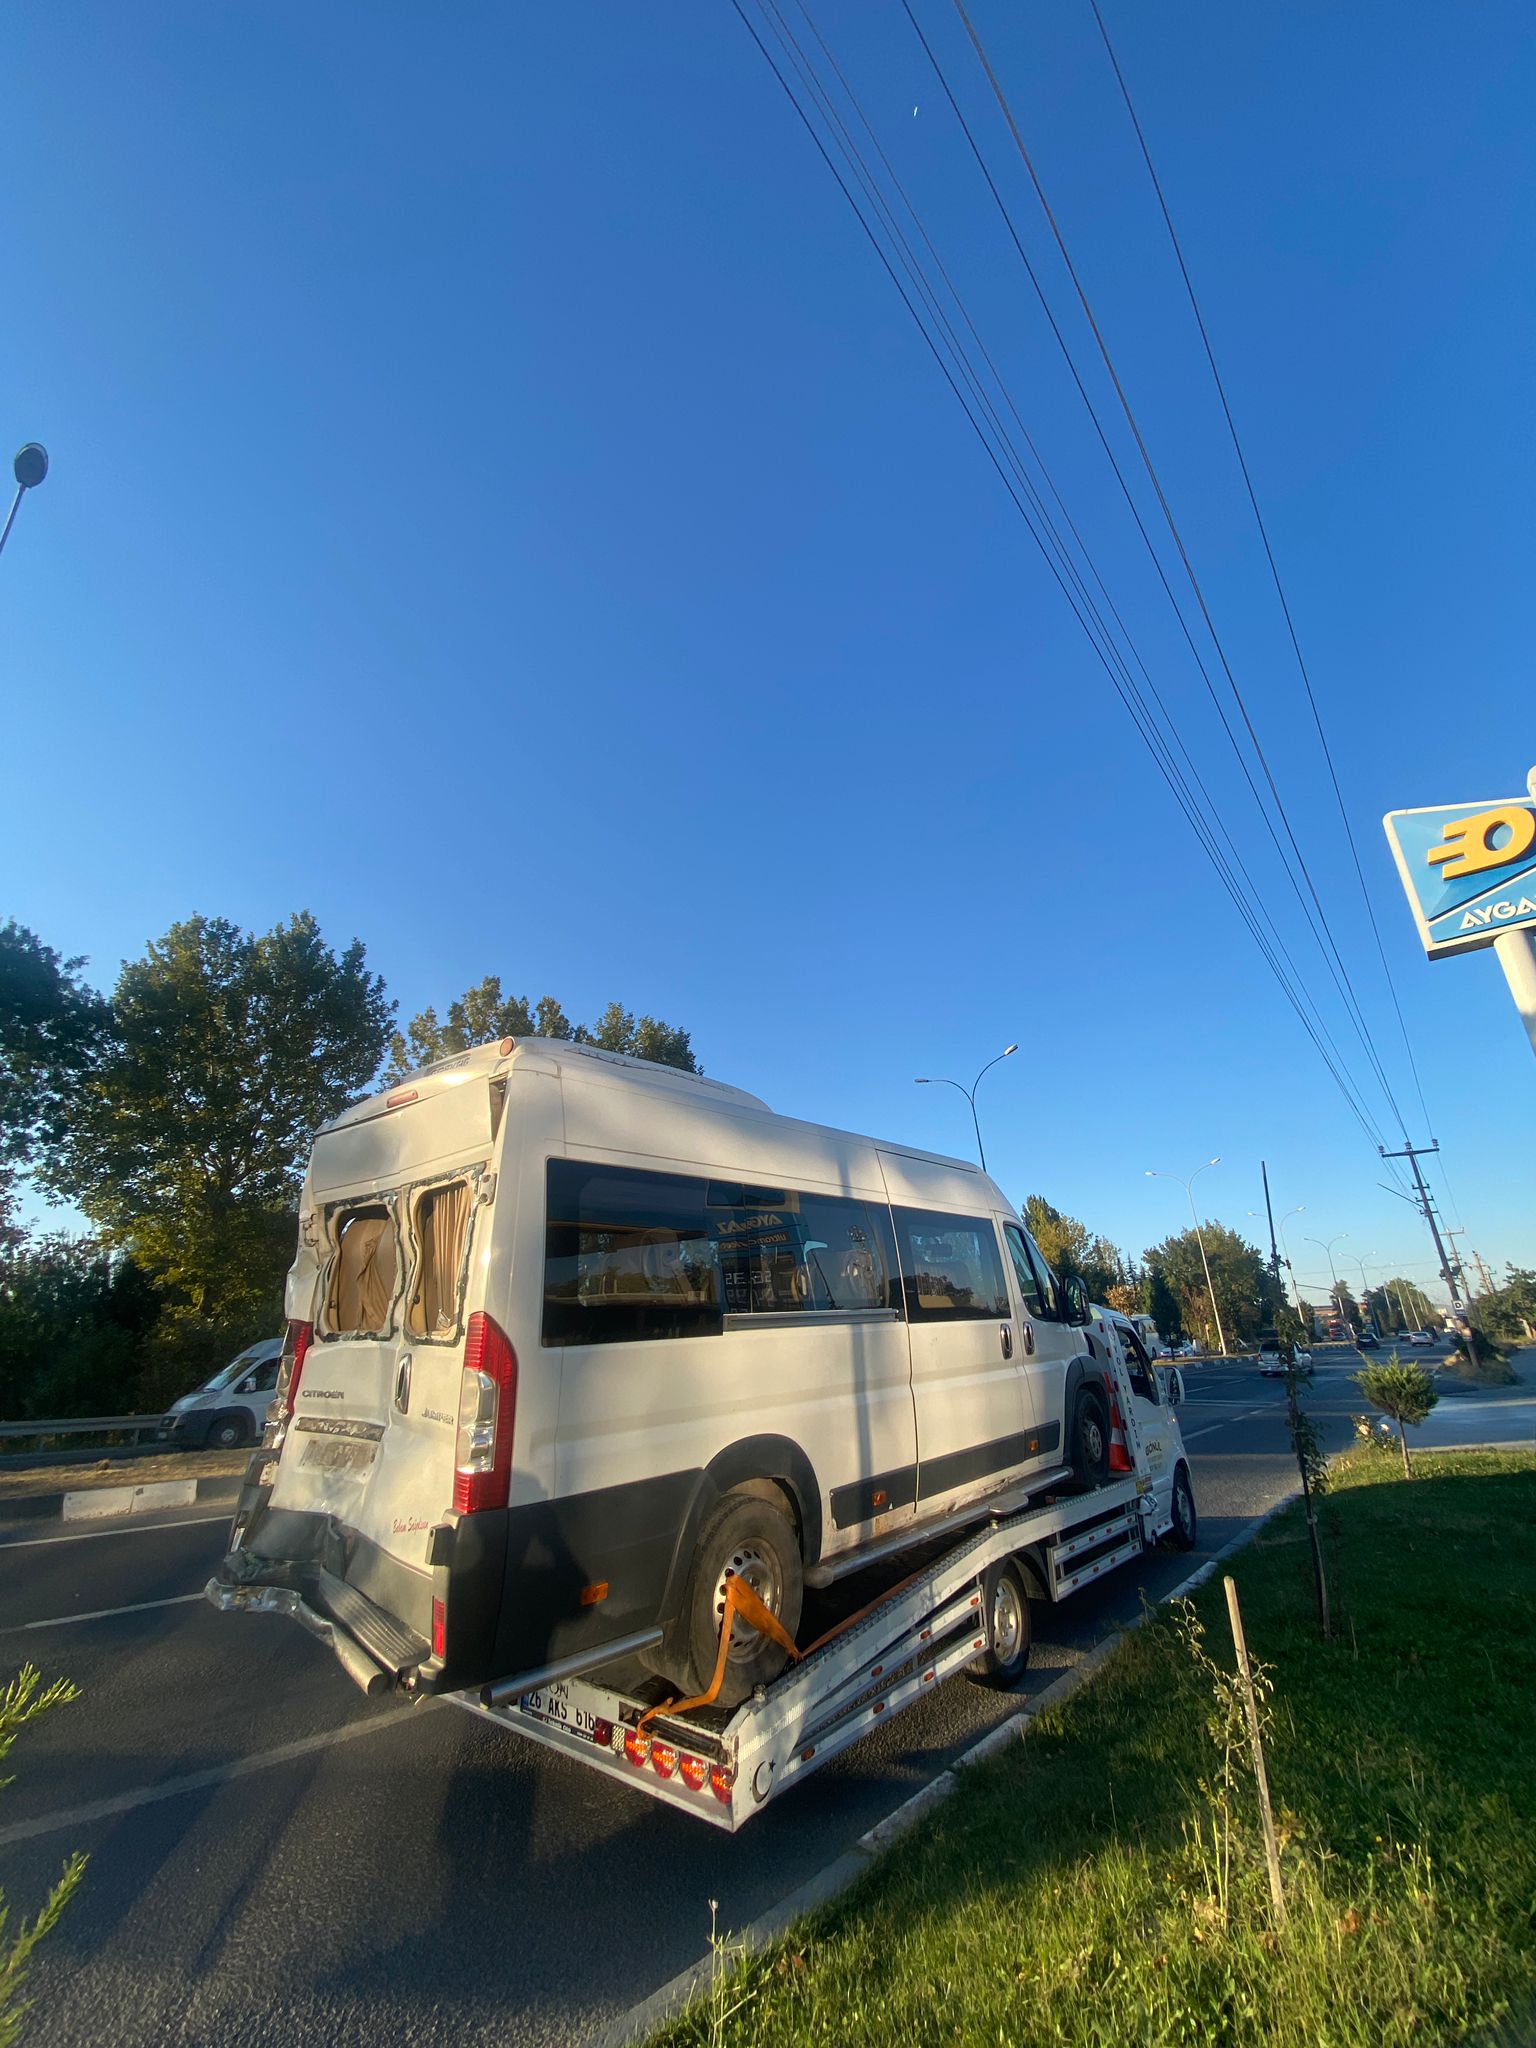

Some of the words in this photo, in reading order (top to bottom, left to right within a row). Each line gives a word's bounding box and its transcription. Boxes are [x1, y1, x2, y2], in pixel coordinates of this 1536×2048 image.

[1459, 896, 1536, 930] AYGA
[421, 1408, 453, 1425] JUMPER
[529, 1691, 541, 1708] 26
[548, 1698, 567, 1719] AKS
[576, 1708, 595, 1730] 616
